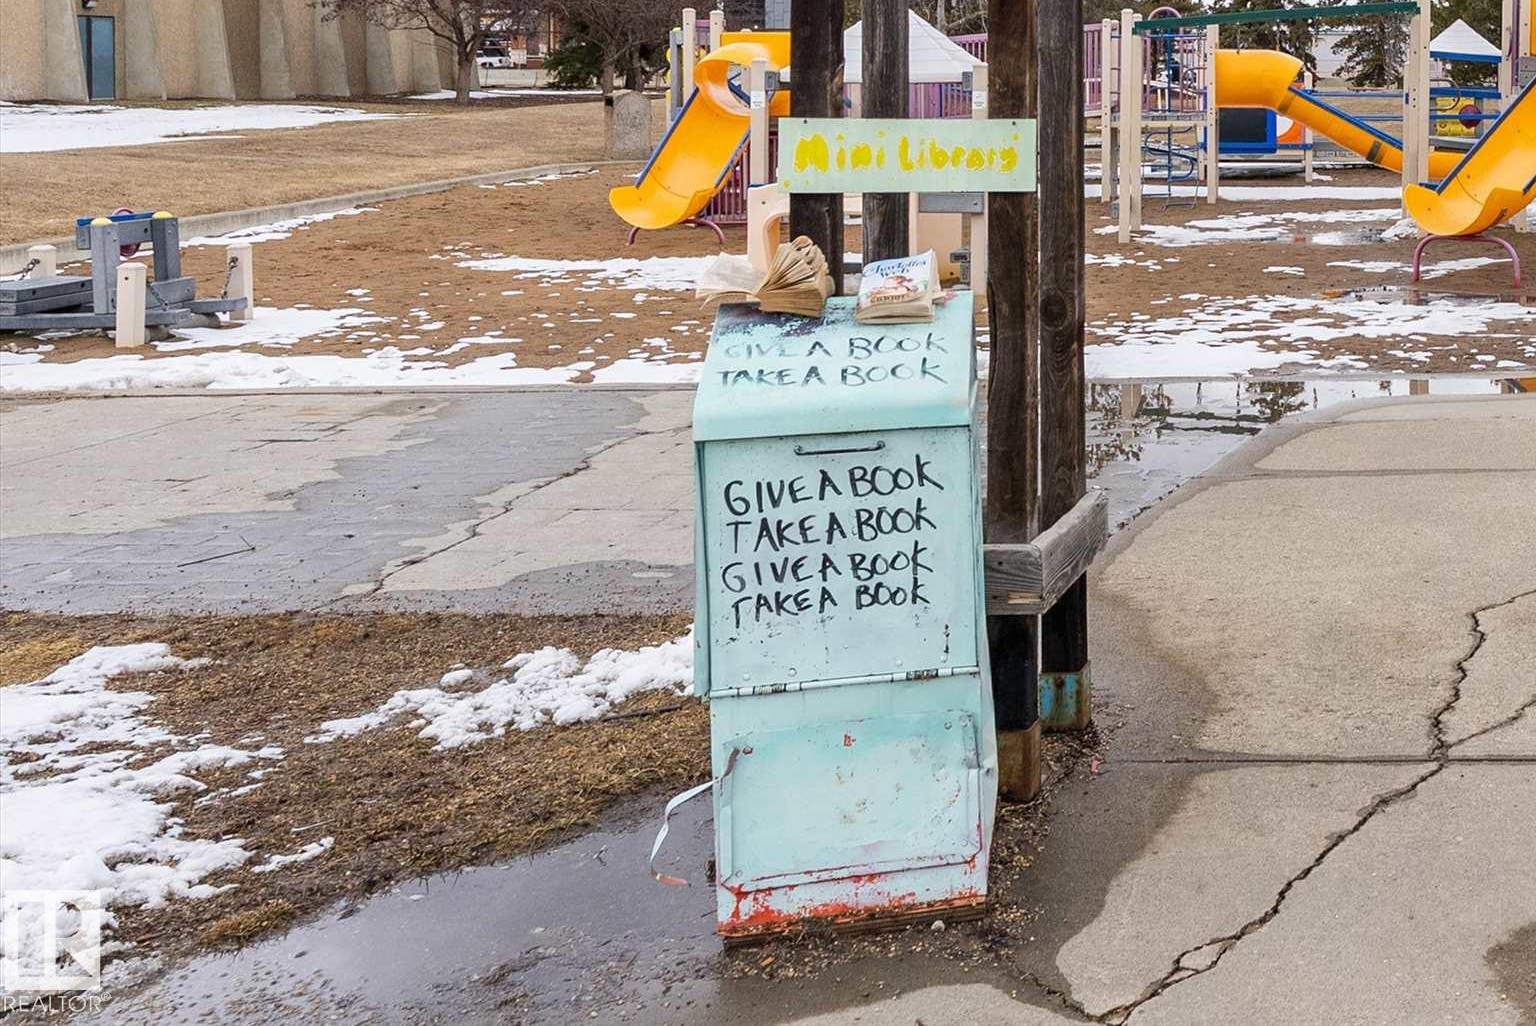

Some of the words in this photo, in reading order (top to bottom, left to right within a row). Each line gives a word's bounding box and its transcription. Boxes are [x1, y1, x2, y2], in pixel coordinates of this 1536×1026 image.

[793, 128, 886, 174] Mini
[897, 131, 1021, 173] Library
[718, 366, 797, 388] TAKE
[802, 365, 827, 387] A
[840, 356, 949, 387] BOOK
[724, 342, 794, 359] GIVE
[806, 340, 833, 358] A
[848, 332, 950, 360] BOOK
[724, 476, 813, 516] GIVE
[818, 469, 842, 501] A
[848, 454, 944, 498] BOOK
[726, 515, 820, 554] TAKE
[826, 512, 847, 545] A
[856, 497, 937, 542] BOOK
[722, 556, 813, 593] GIVE
[818, 552, 842, 582] A
[848, 540, 934, 582] BOOK
[731, 588, 813, 629] TAKE
[818, 586, 838, 614] A
[856, 577, 931, 610] BOOK
